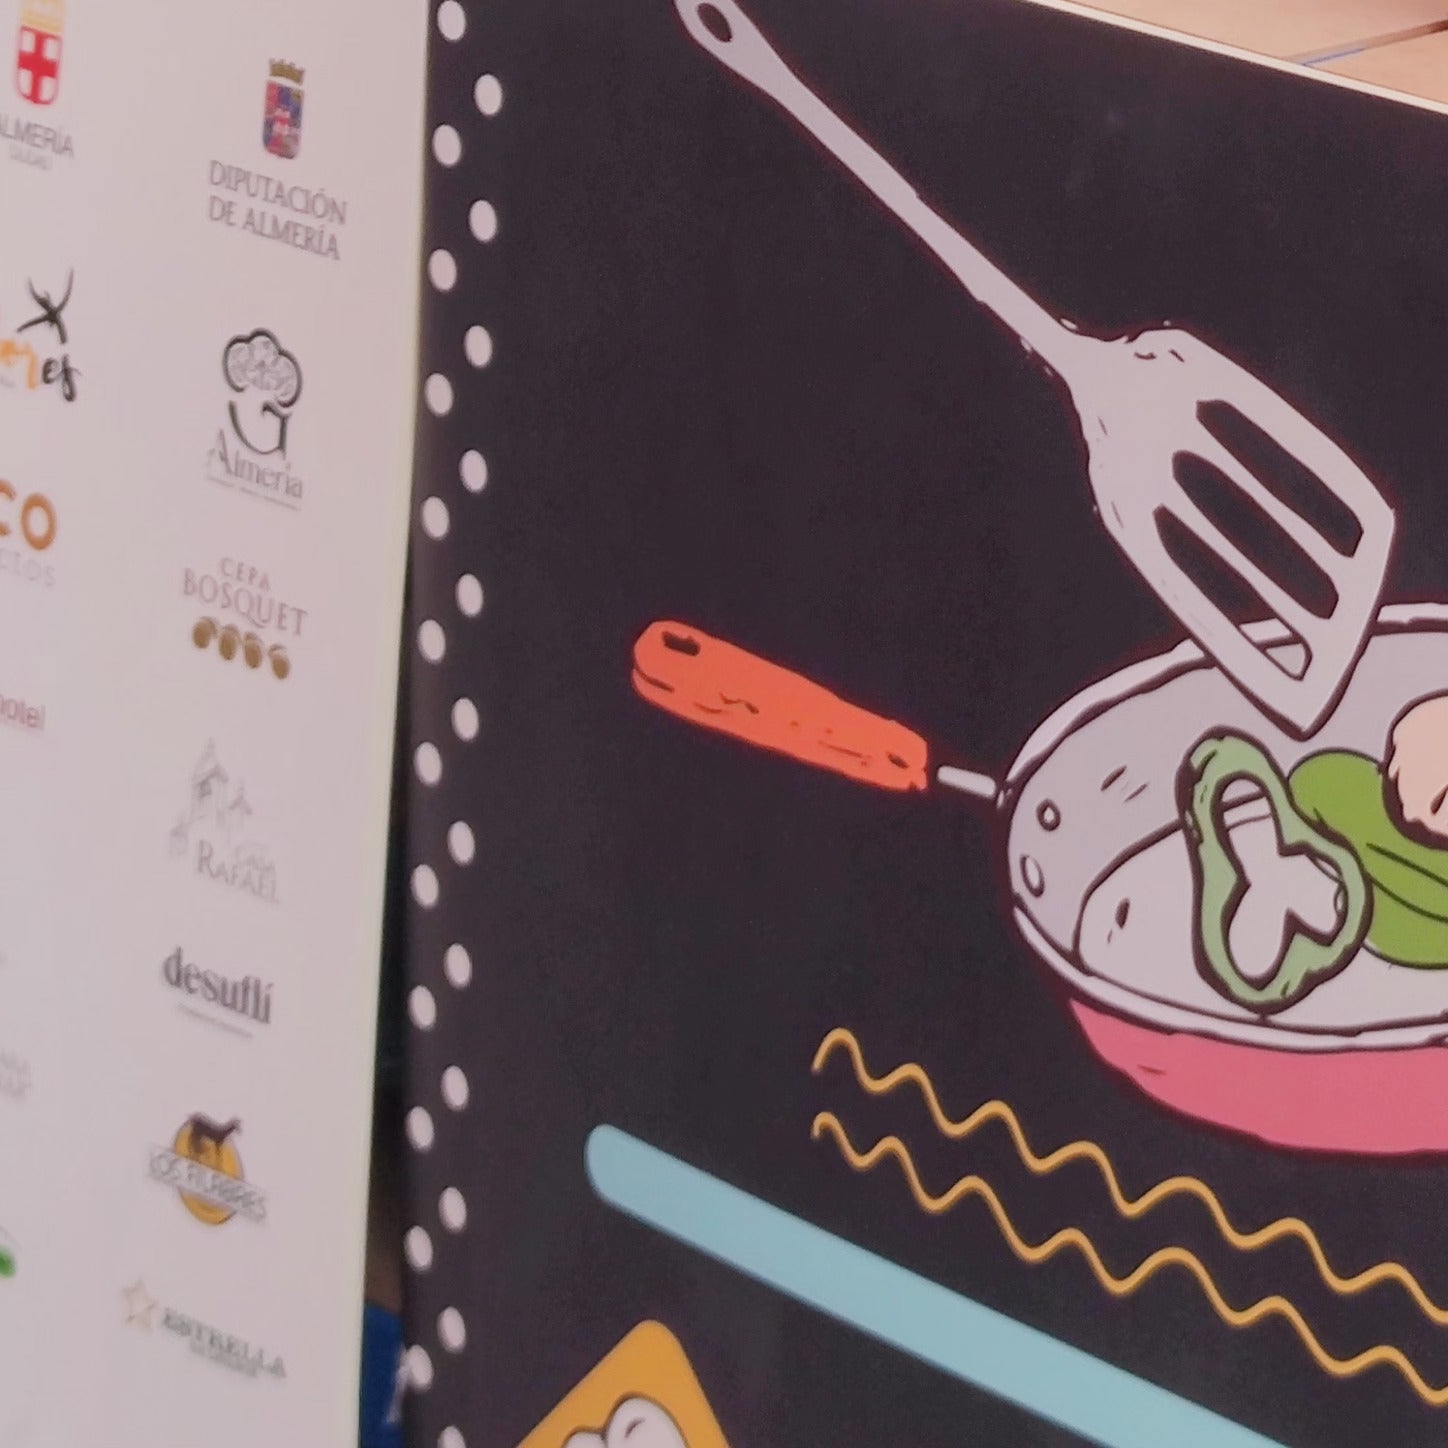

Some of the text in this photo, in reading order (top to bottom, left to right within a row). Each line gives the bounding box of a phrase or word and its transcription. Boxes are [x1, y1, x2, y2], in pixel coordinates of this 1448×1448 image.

[208, 159, 348, 225] DIPUTACIÓN
[208, 195, 341, 261] DE ALMERÍA
[183, 567, 308, 636] BOSQUET
[220, 557, 271, 593] CEPA
